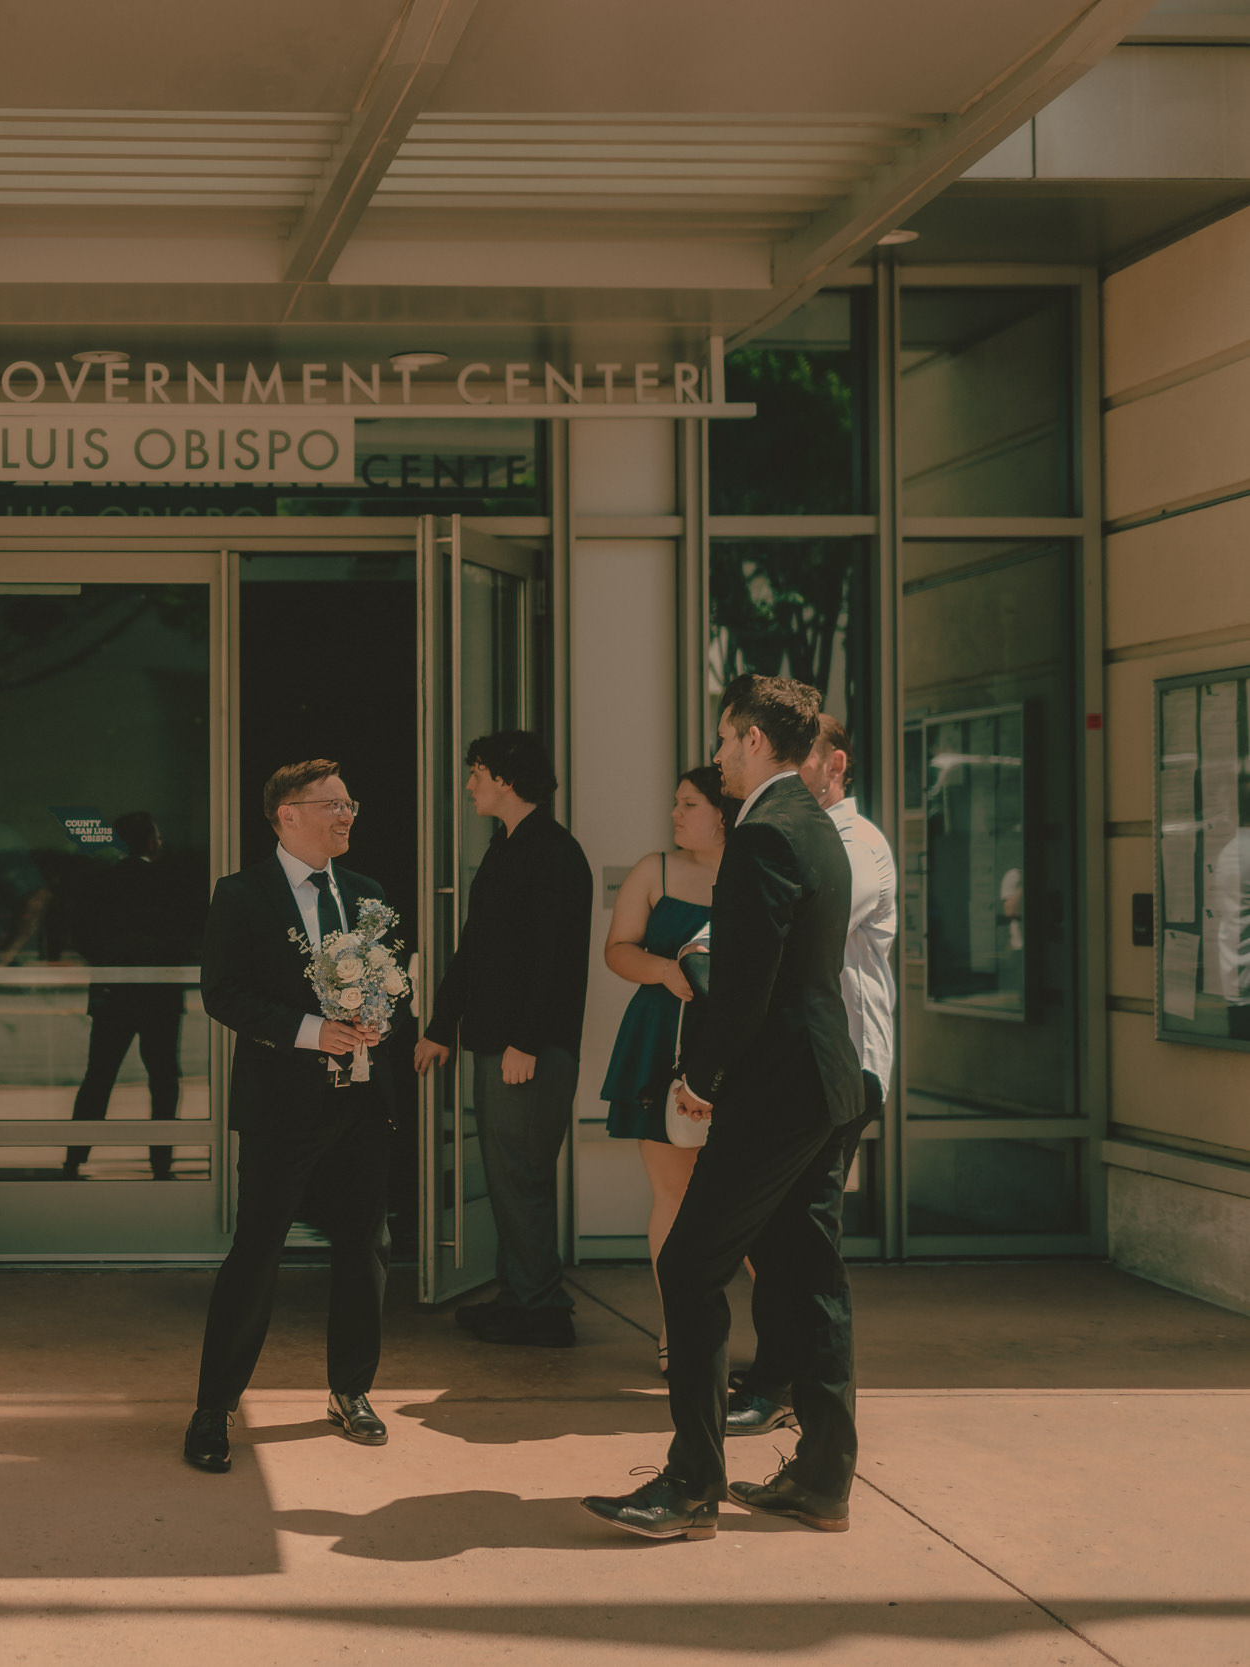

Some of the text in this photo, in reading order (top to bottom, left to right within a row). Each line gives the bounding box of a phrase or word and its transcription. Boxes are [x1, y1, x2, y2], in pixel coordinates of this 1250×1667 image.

[456, 361, 705, 404] CENTER
[0, 427, 110, 471] LUIS
[133, 428, 340, 472] OBISPO
